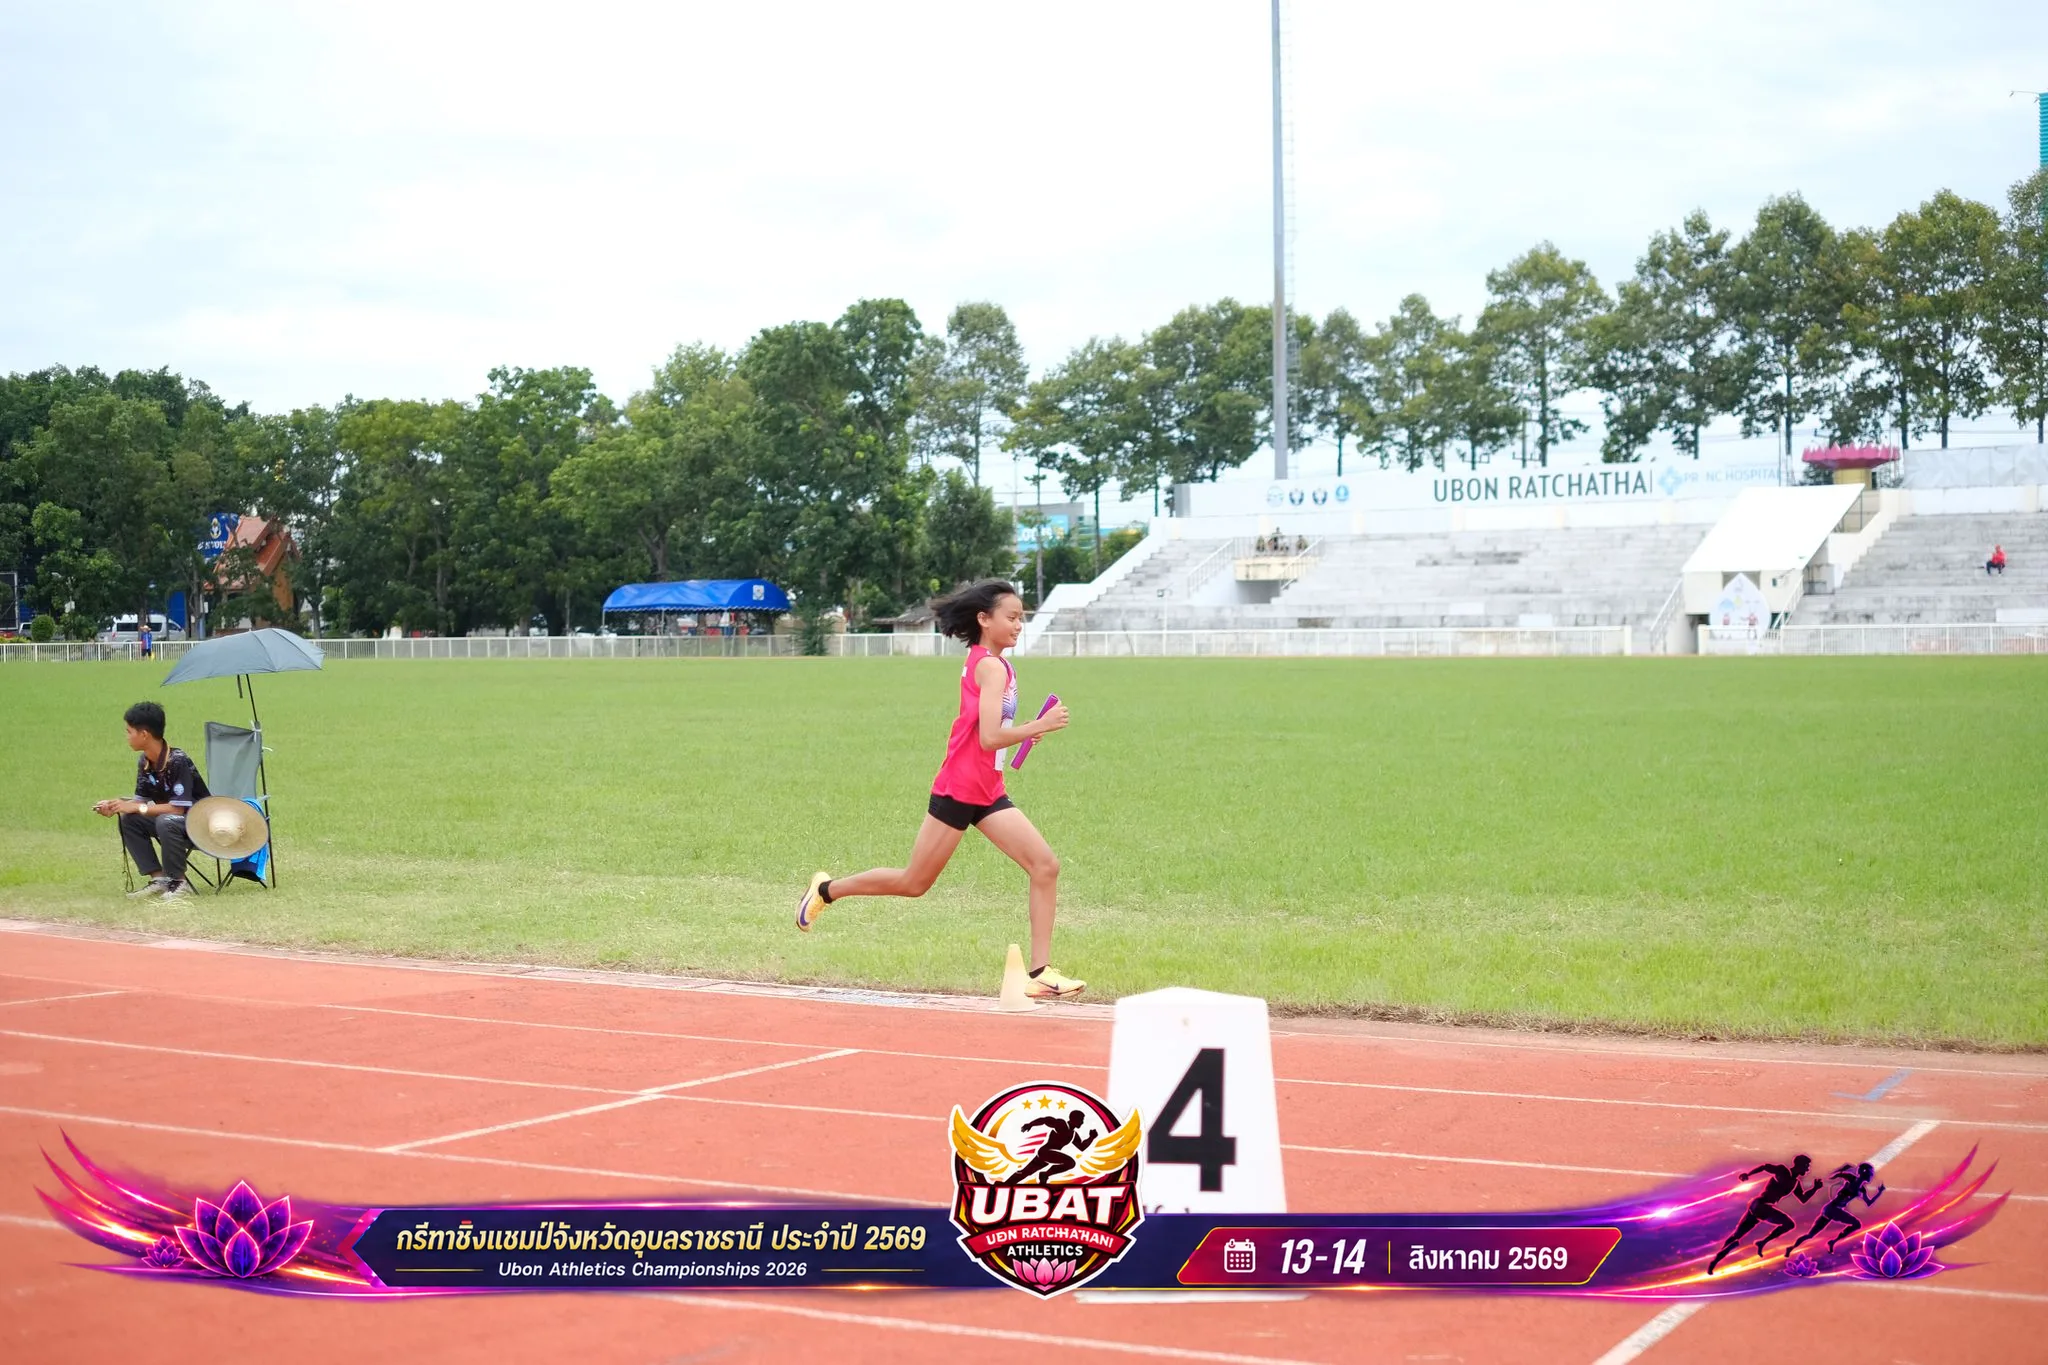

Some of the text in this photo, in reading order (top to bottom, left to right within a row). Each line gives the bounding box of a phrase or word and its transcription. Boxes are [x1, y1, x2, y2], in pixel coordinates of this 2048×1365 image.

[1434, 470, 1653, 502] UBON RATCHATHA
[1147, 1048, 1237, 1192] 4
